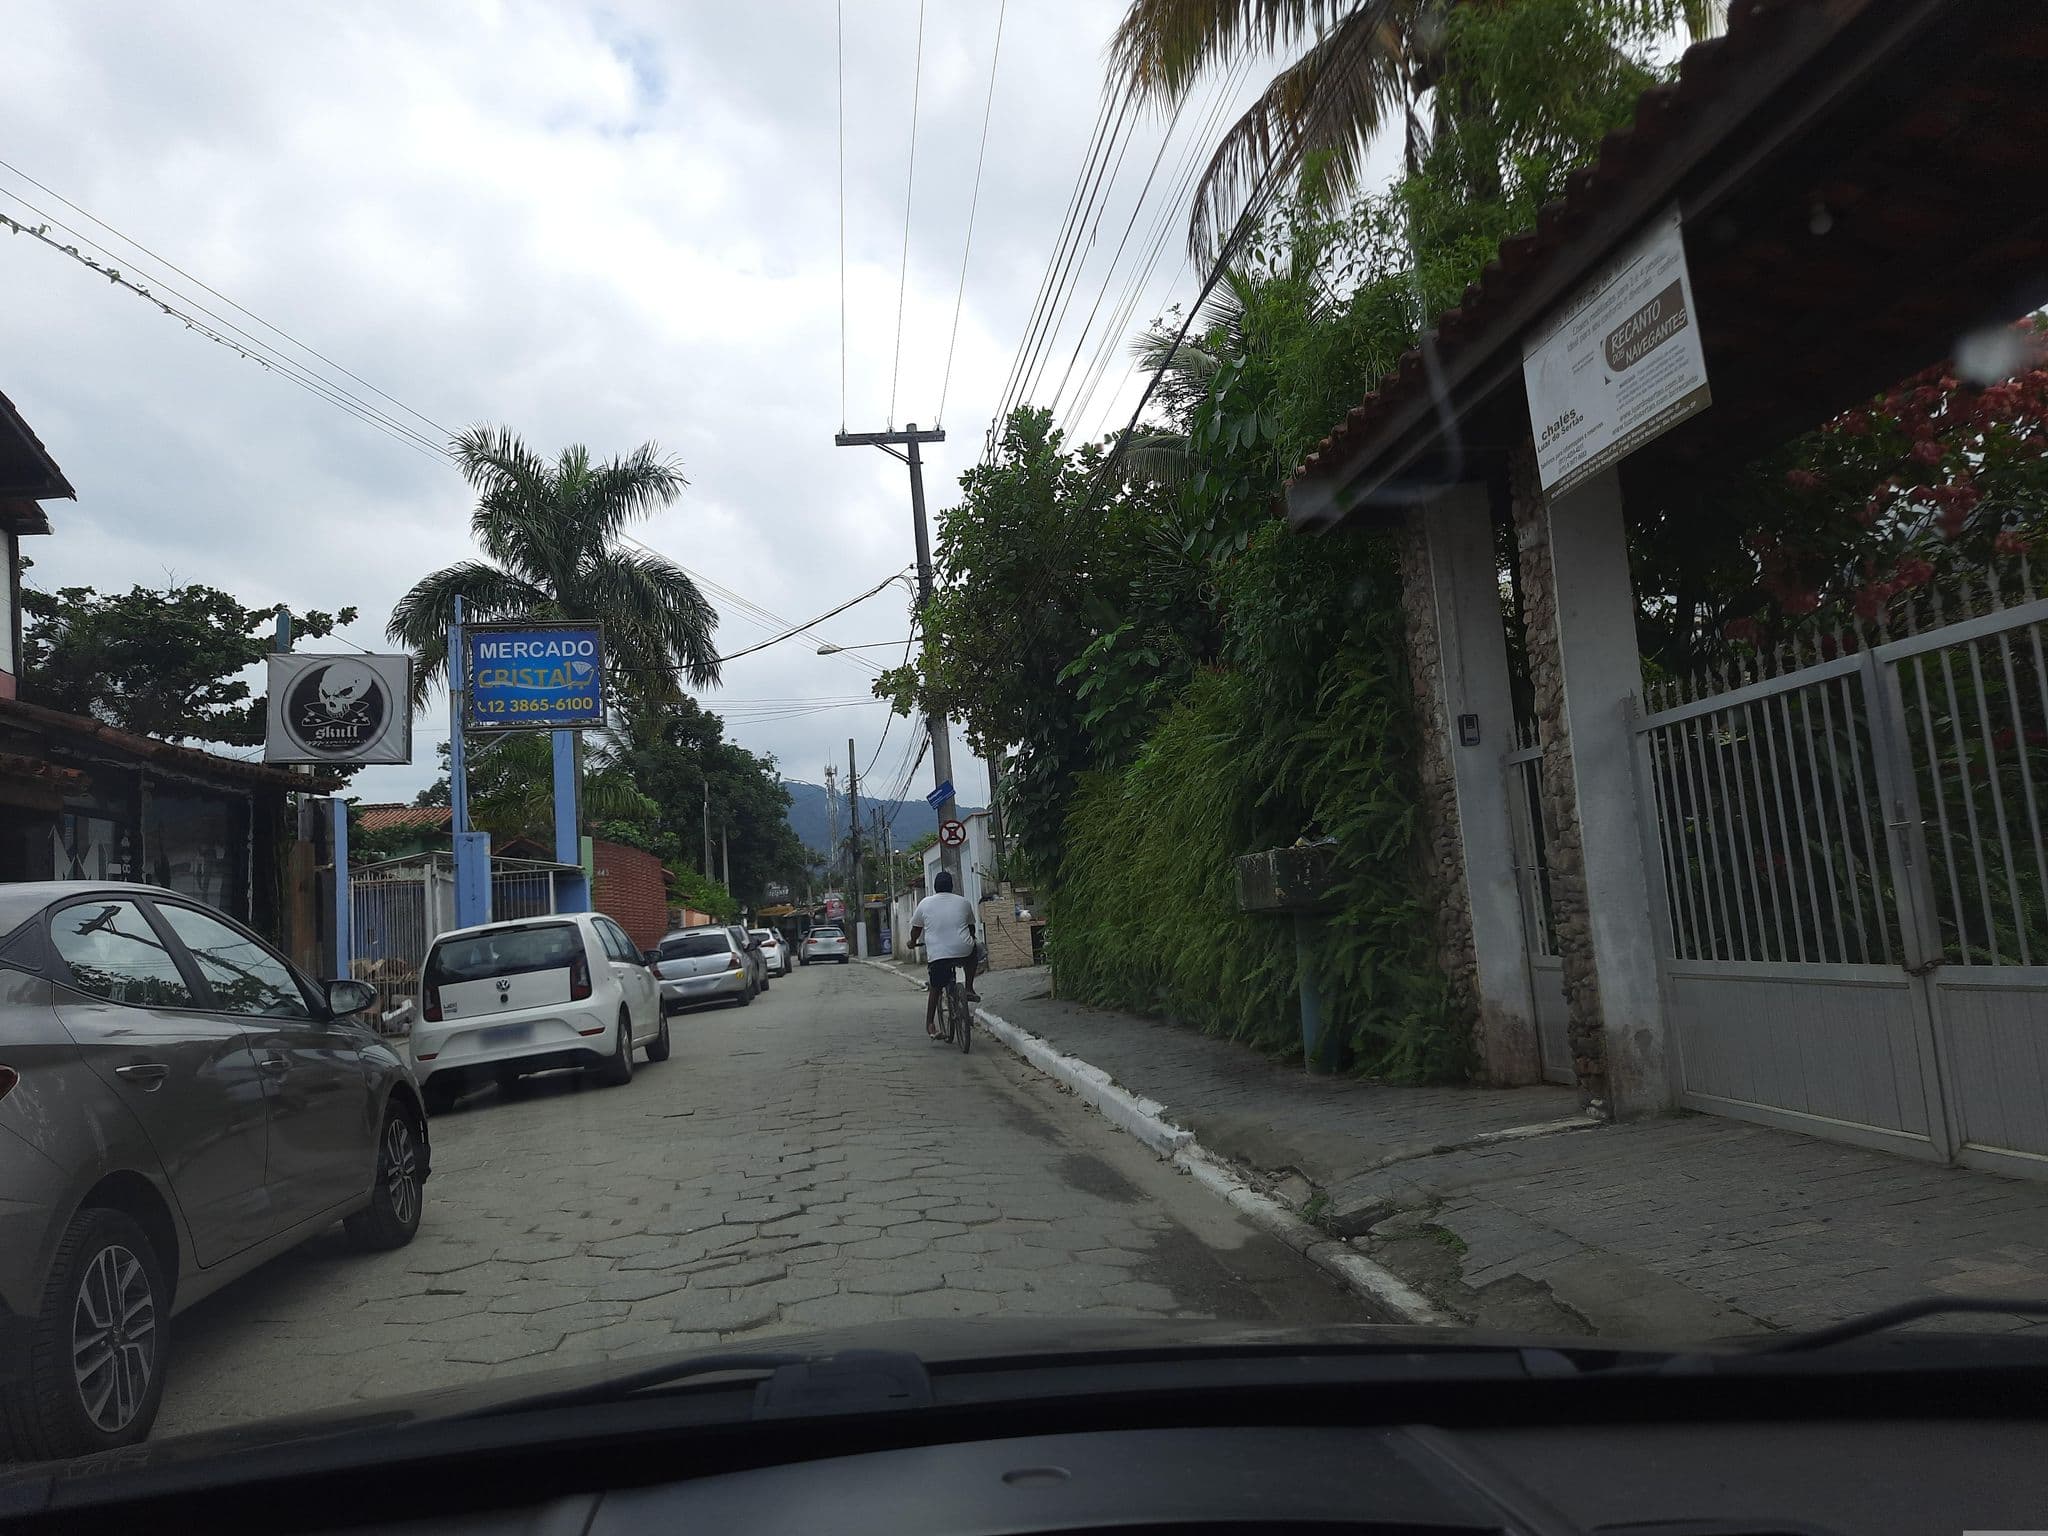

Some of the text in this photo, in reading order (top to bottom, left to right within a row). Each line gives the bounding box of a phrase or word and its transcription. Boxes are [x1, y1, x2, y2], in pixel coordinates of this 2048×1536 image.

[1611, 300, 1661, 353] RECANTO
[1612, 349, 1625, 364] DOS
[1625, 308, 1687, 366] NAVEGANTES
[1537, 415, 1584, 453] Luar do Sertão
[1541, 408, 1576, 441] chalés
[480, 640, 594, 659] MERCADO
[478, 661, 595, 690] CRISTAL
[488, 697, 593, 713] 12 3865-6100
[315, 725, 358, 740] skull
